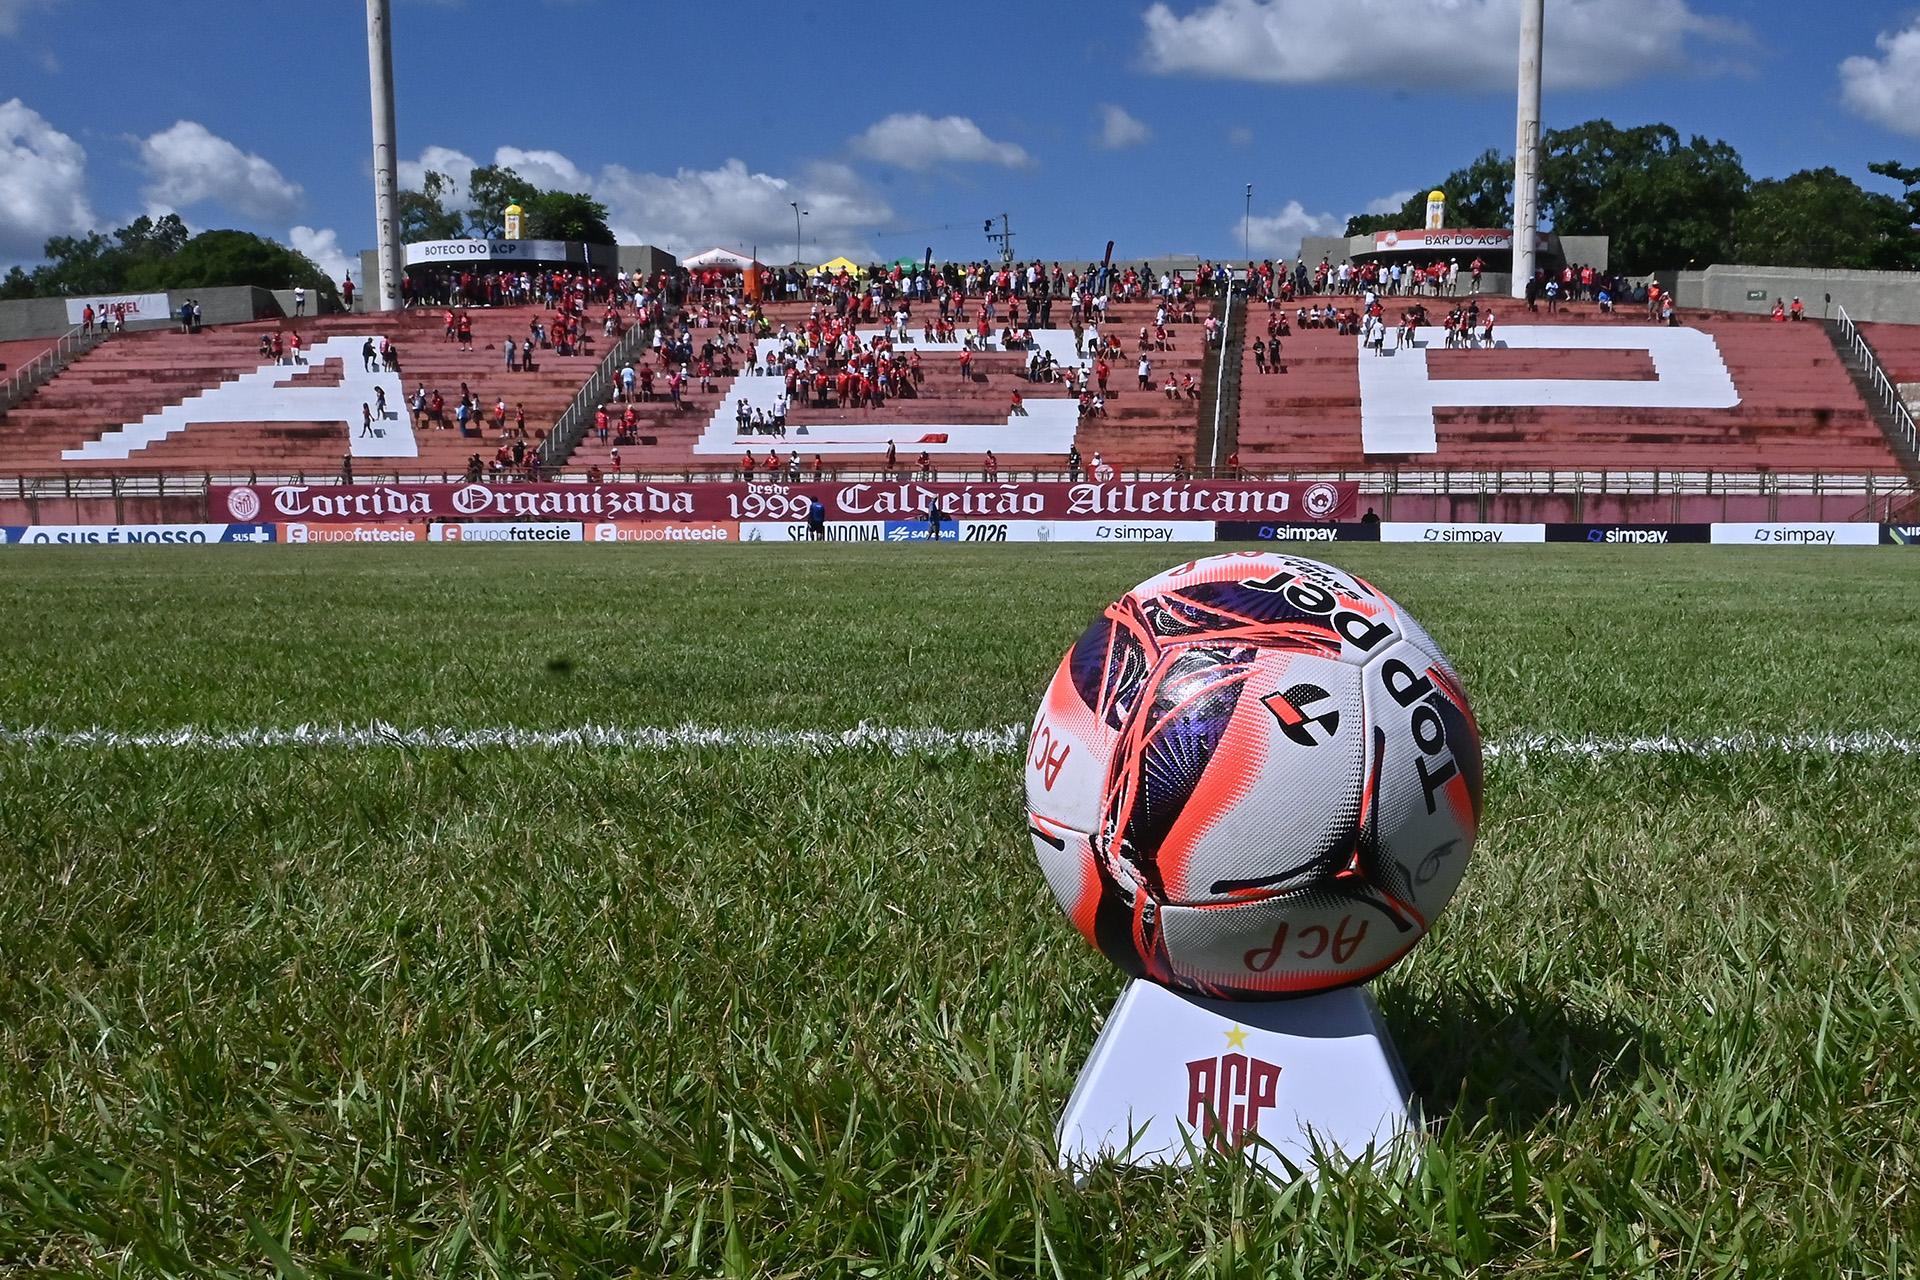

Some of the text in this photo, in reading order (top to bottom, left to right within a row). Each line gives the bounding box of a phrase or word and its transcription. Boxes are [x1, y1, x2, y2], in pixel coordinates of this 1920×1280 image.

[1425, 235, 1503, 246] BAR DO ACP
[425, 243, 517, 256] BOTECO DO ACP
[747, 482, 790, 495] desde
[271, 486, 433, 516] Torcida
[452, 484, 695, 519] Organizada
[726, 493, 812, 519] 1999
[836, 483, 1045, 515] Caldeirão
[1067, 482, 1290, 515] Atleticano
[60, 531, 99, 543] SUS
[107, 528, 119, 543] É
[128, 531, 206, 543] NOSSO
[232, 533, 249, 542] SUS
[966, 524, 1008, 541] 2026
[1186, 1053, 1283, 1158] ACP
